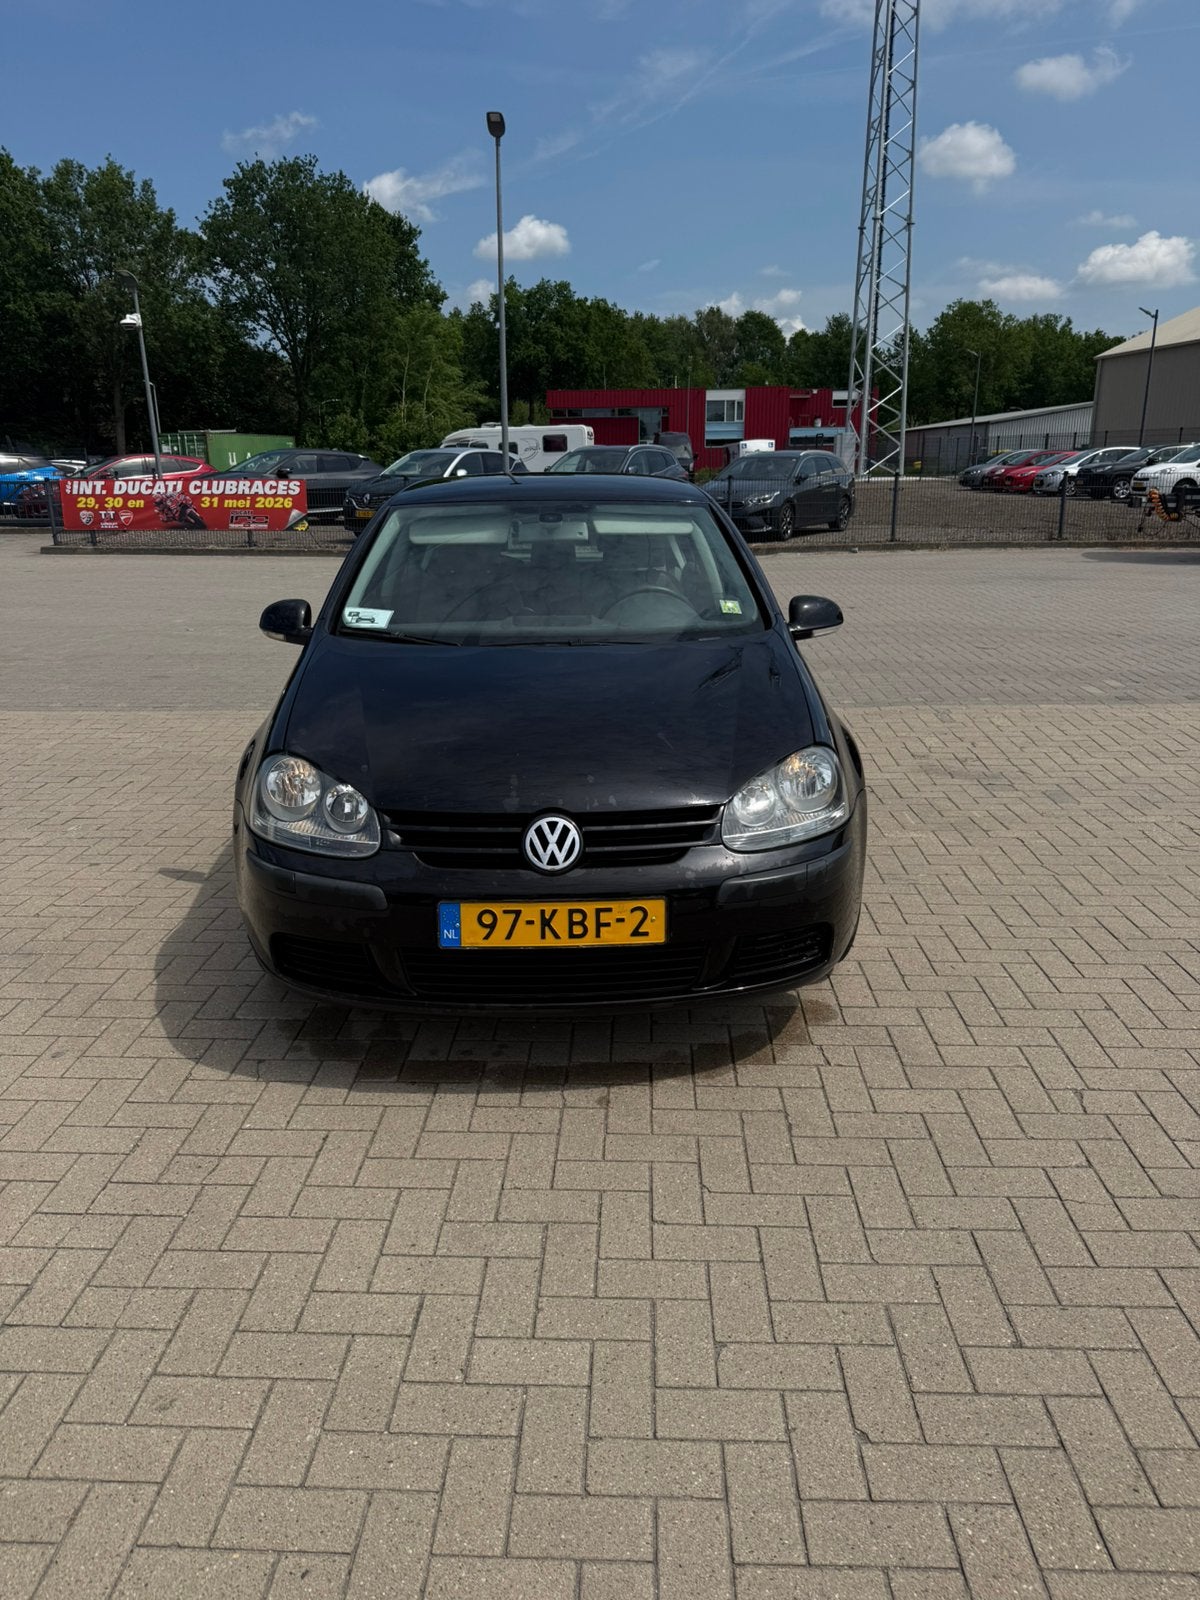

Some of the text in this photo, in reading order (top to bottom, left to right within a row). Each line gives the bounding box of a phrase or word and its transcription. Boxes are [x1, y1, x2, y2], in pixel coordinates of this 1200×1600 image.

[72, 480, 301, 495] INT. DUCATI CLUBRACES
[76, 496, 145, 509] 29, 30 en
[200, 497, 293, 508] 31 mei 2026
[476, 905, 650, 941] 97-KBF-2
[443, 929, 459, 940] NL
